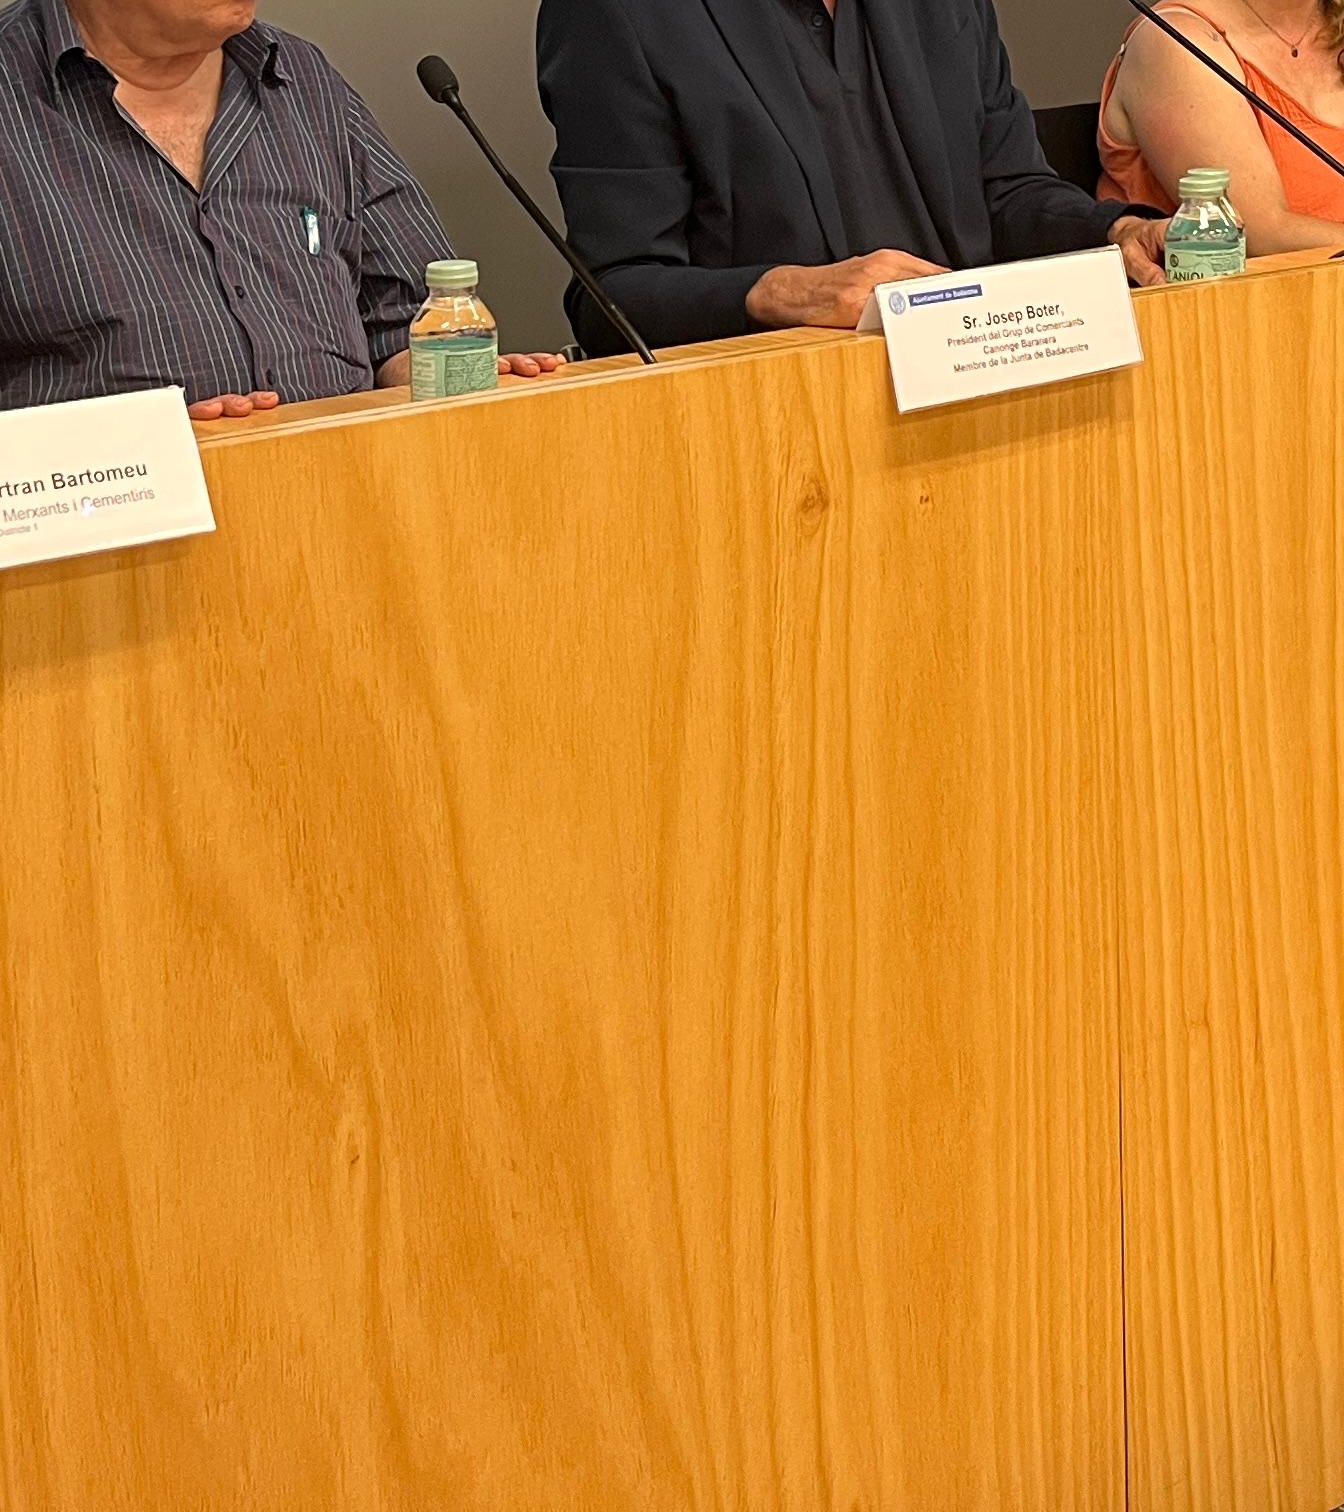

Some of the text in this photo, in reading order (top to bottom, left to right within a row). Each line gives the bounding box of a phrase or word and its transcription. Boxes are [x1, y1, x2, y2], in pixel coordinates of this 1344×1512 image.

[963, 304, 1065, 329] Sr. Josep Boter,
[947, 333, 988, 347] President
[1002, 328, 1023, 338] Grup
[1024, 325, 1034, 334] de
[983, 341, 1020, 354] Canonge
[989, 358, 999, 367] de
[1000, 355, 1008, 365] la
[1010, 352, 1032, 363] Junta
[1034, 349, 1044, 359] de
[51, 463, 148, 490] Bartomeu
[3, 501, 70, 522] Merxants
[81, 488, 156, 509] Cementiris
